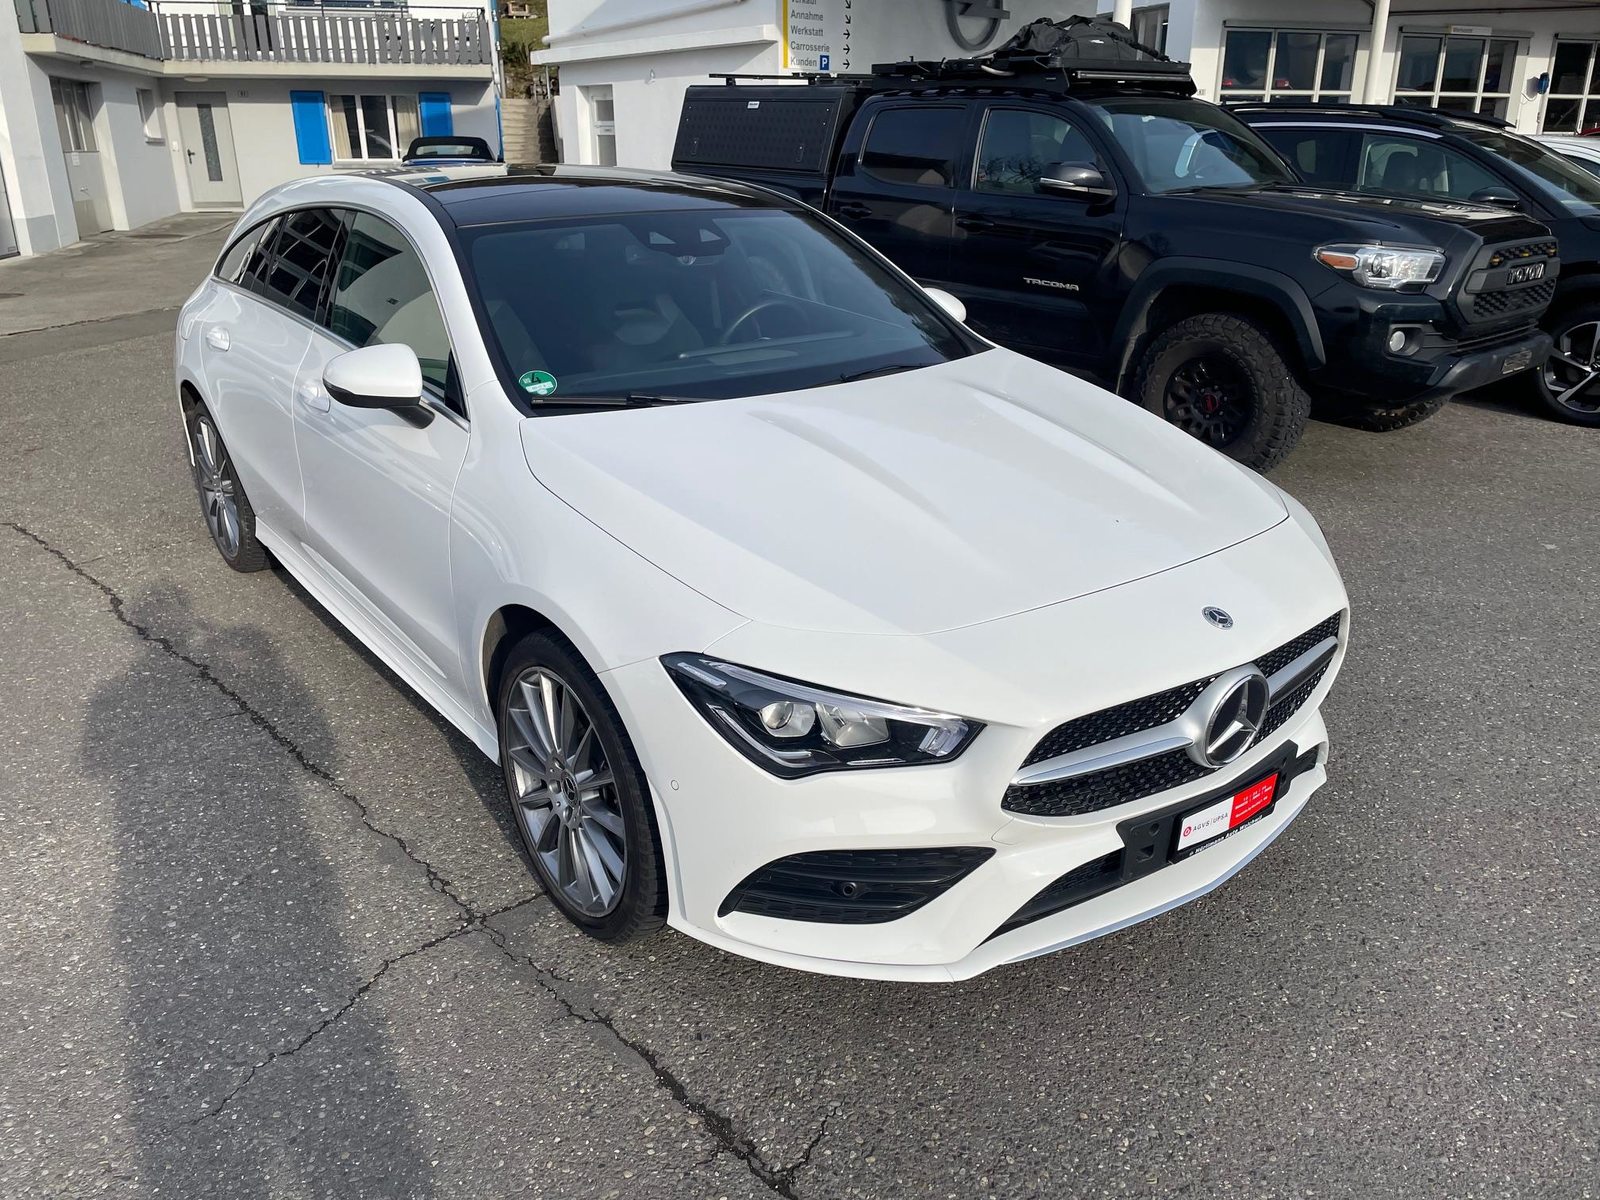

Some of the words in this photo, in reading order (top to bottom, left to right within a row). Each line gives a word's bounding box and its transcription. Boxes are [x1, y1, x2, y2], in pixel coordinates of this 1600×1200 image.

[790, 9, 824, 21] Annahme
[790, 25, 824, 37] Werkstatt
[790, 41, 830, 53] Carrosserie
[790, 57, 817, 67] Kunden
[821, 56, 828, 68] P
[1022, 277, 1079, 291] TACOMA
[1193, 820, 1210, 832] AGVS
